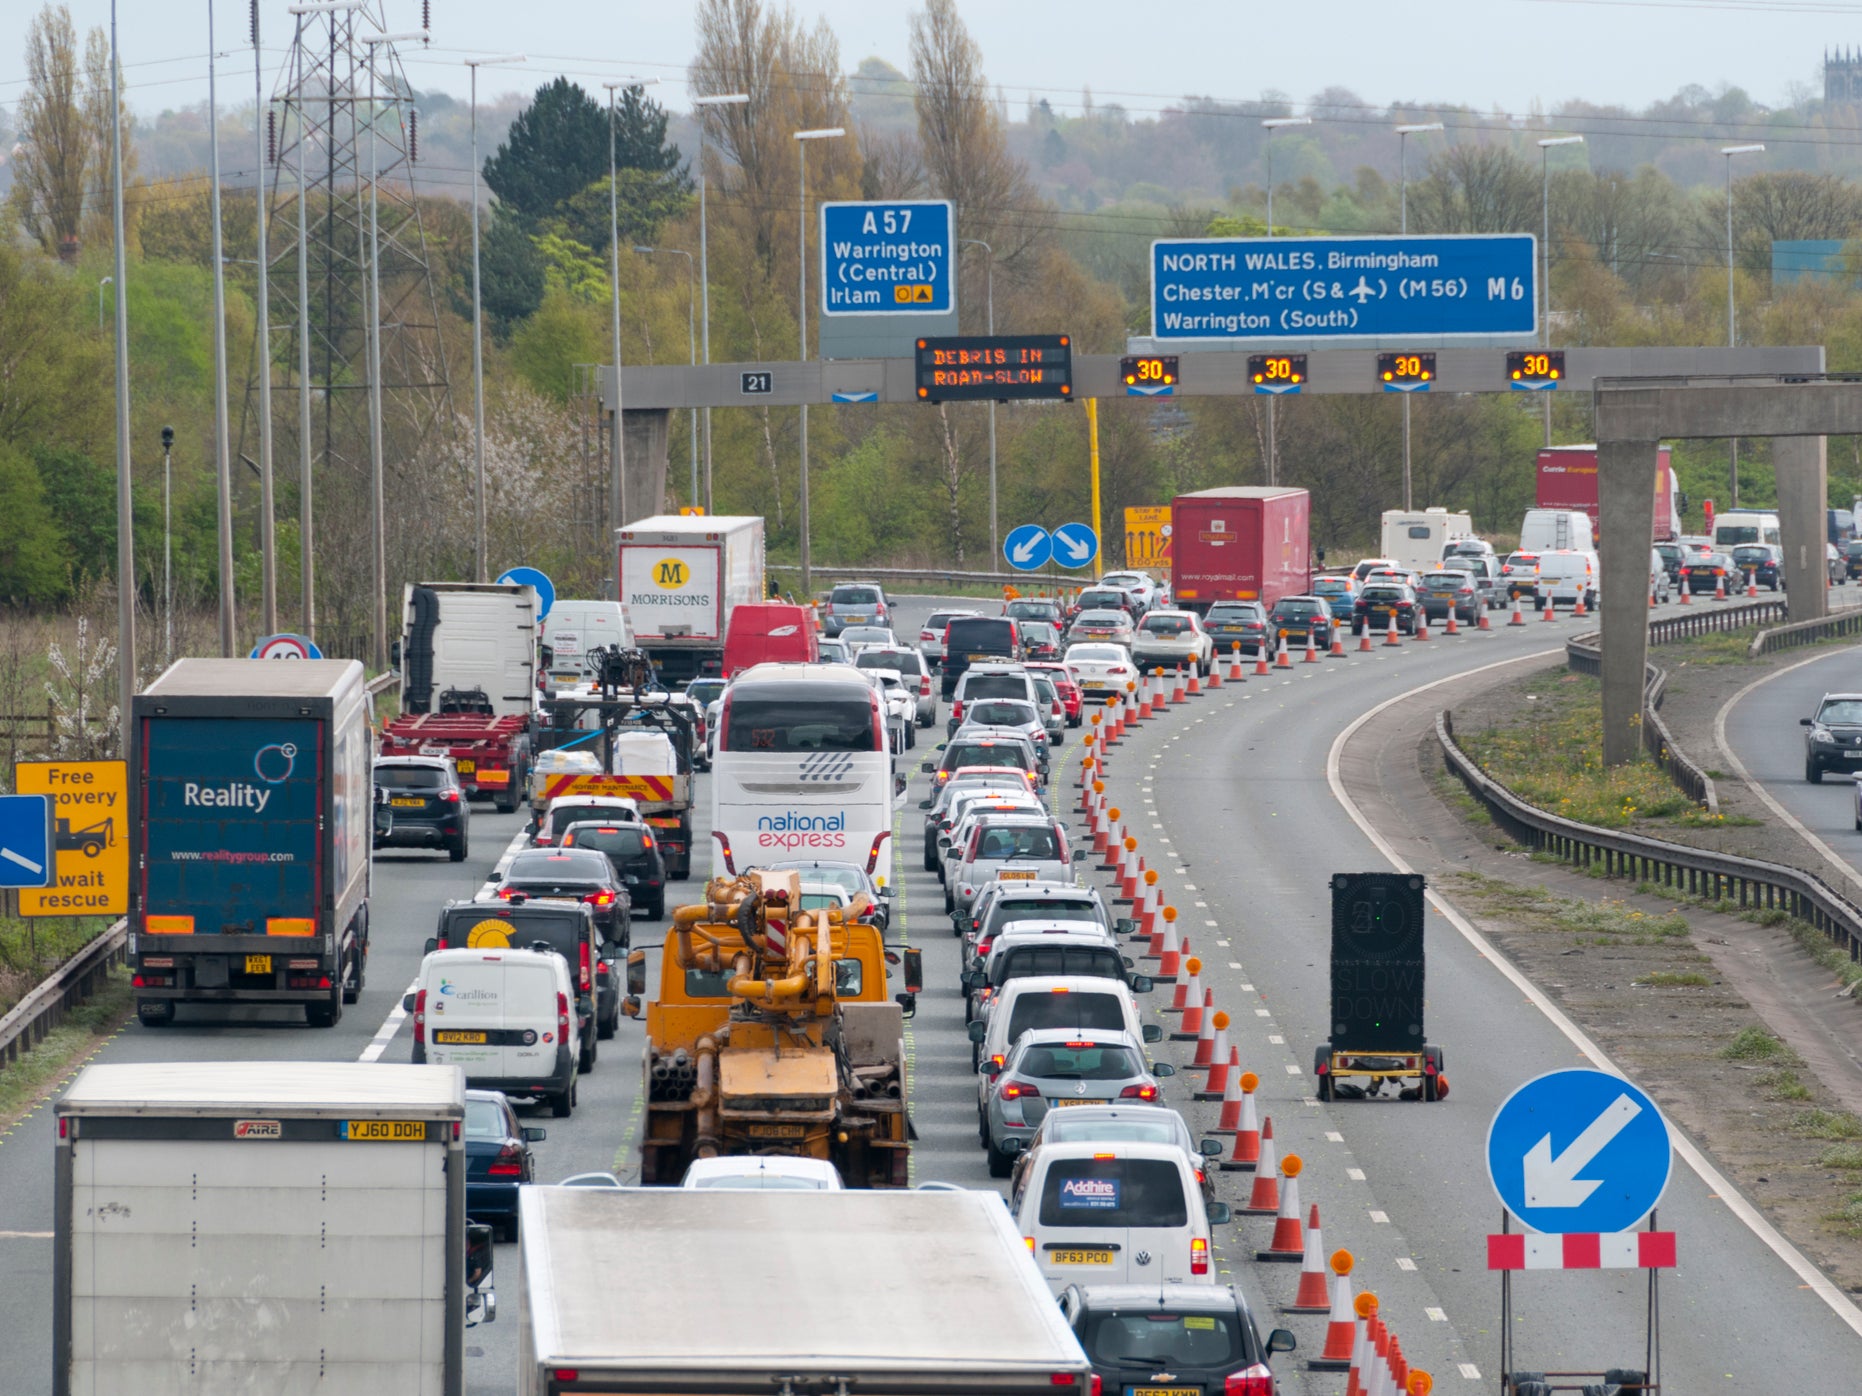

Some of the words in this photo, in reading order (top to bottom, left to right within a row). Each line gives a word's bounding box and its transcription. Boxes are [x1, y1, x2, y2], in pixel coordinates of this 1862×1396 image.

[833, 241, 942, 261] Warrington
[1163, 253, 1236, 271] NORTH
[1328, 250, 1439, 271] Birmingham
[838, 260, 937, 283] (Central)
[831, 287, 881, 304] Irlam
[1163, 312, 1271, 332] Warrington
[1280, 308, 1359, 330] (South)
[934, 349, 1006, 365] DEBRIS
[1020, 348, 1042, 363] IN
[1523, 354, 1548, 375] 30
[1136, 359, 1163, 380] 30
[1265, 358, 1291, 378] 30
[1395, 356, 1420, 376] 30
[748, 376, 766, 390] 21
[659, 563, 682, 584] M
[1181, 572, 1254, 582] www.royalmail.com
[631, 594, 709, 606] MORRISONS
[752, 728, 775, 748] 532
[48, 768, 94, 785] Free
[572, 783, 599, 791] HIGHWAY
[53, 791, 117, 807] covery
[184, 782, 271, 813] Reality
[758, 811, 844, 831] national
[759, 832, 845, 852] express
[172, 849, 294, 863] www.realitygroup.com
[57, 871, 105, 887] wait
[39, 893, 109, 907] rescue
[1337, 968, 1416, 992] SLOW
[456, 989, 497, 1000] carillion
[1337, 997, 1418, 1019] DOWN
[442, 1032, 460, 1042] BV12
[351, 1124, 389, 1137] YJ60
[393, 1123, 423, 1137] DOH
[1063, 1180, 1114, 1194] Addhire
[1055, 1252, 1084, 1263] BF63
[1086, 1252, 1108, 1263] PCO
